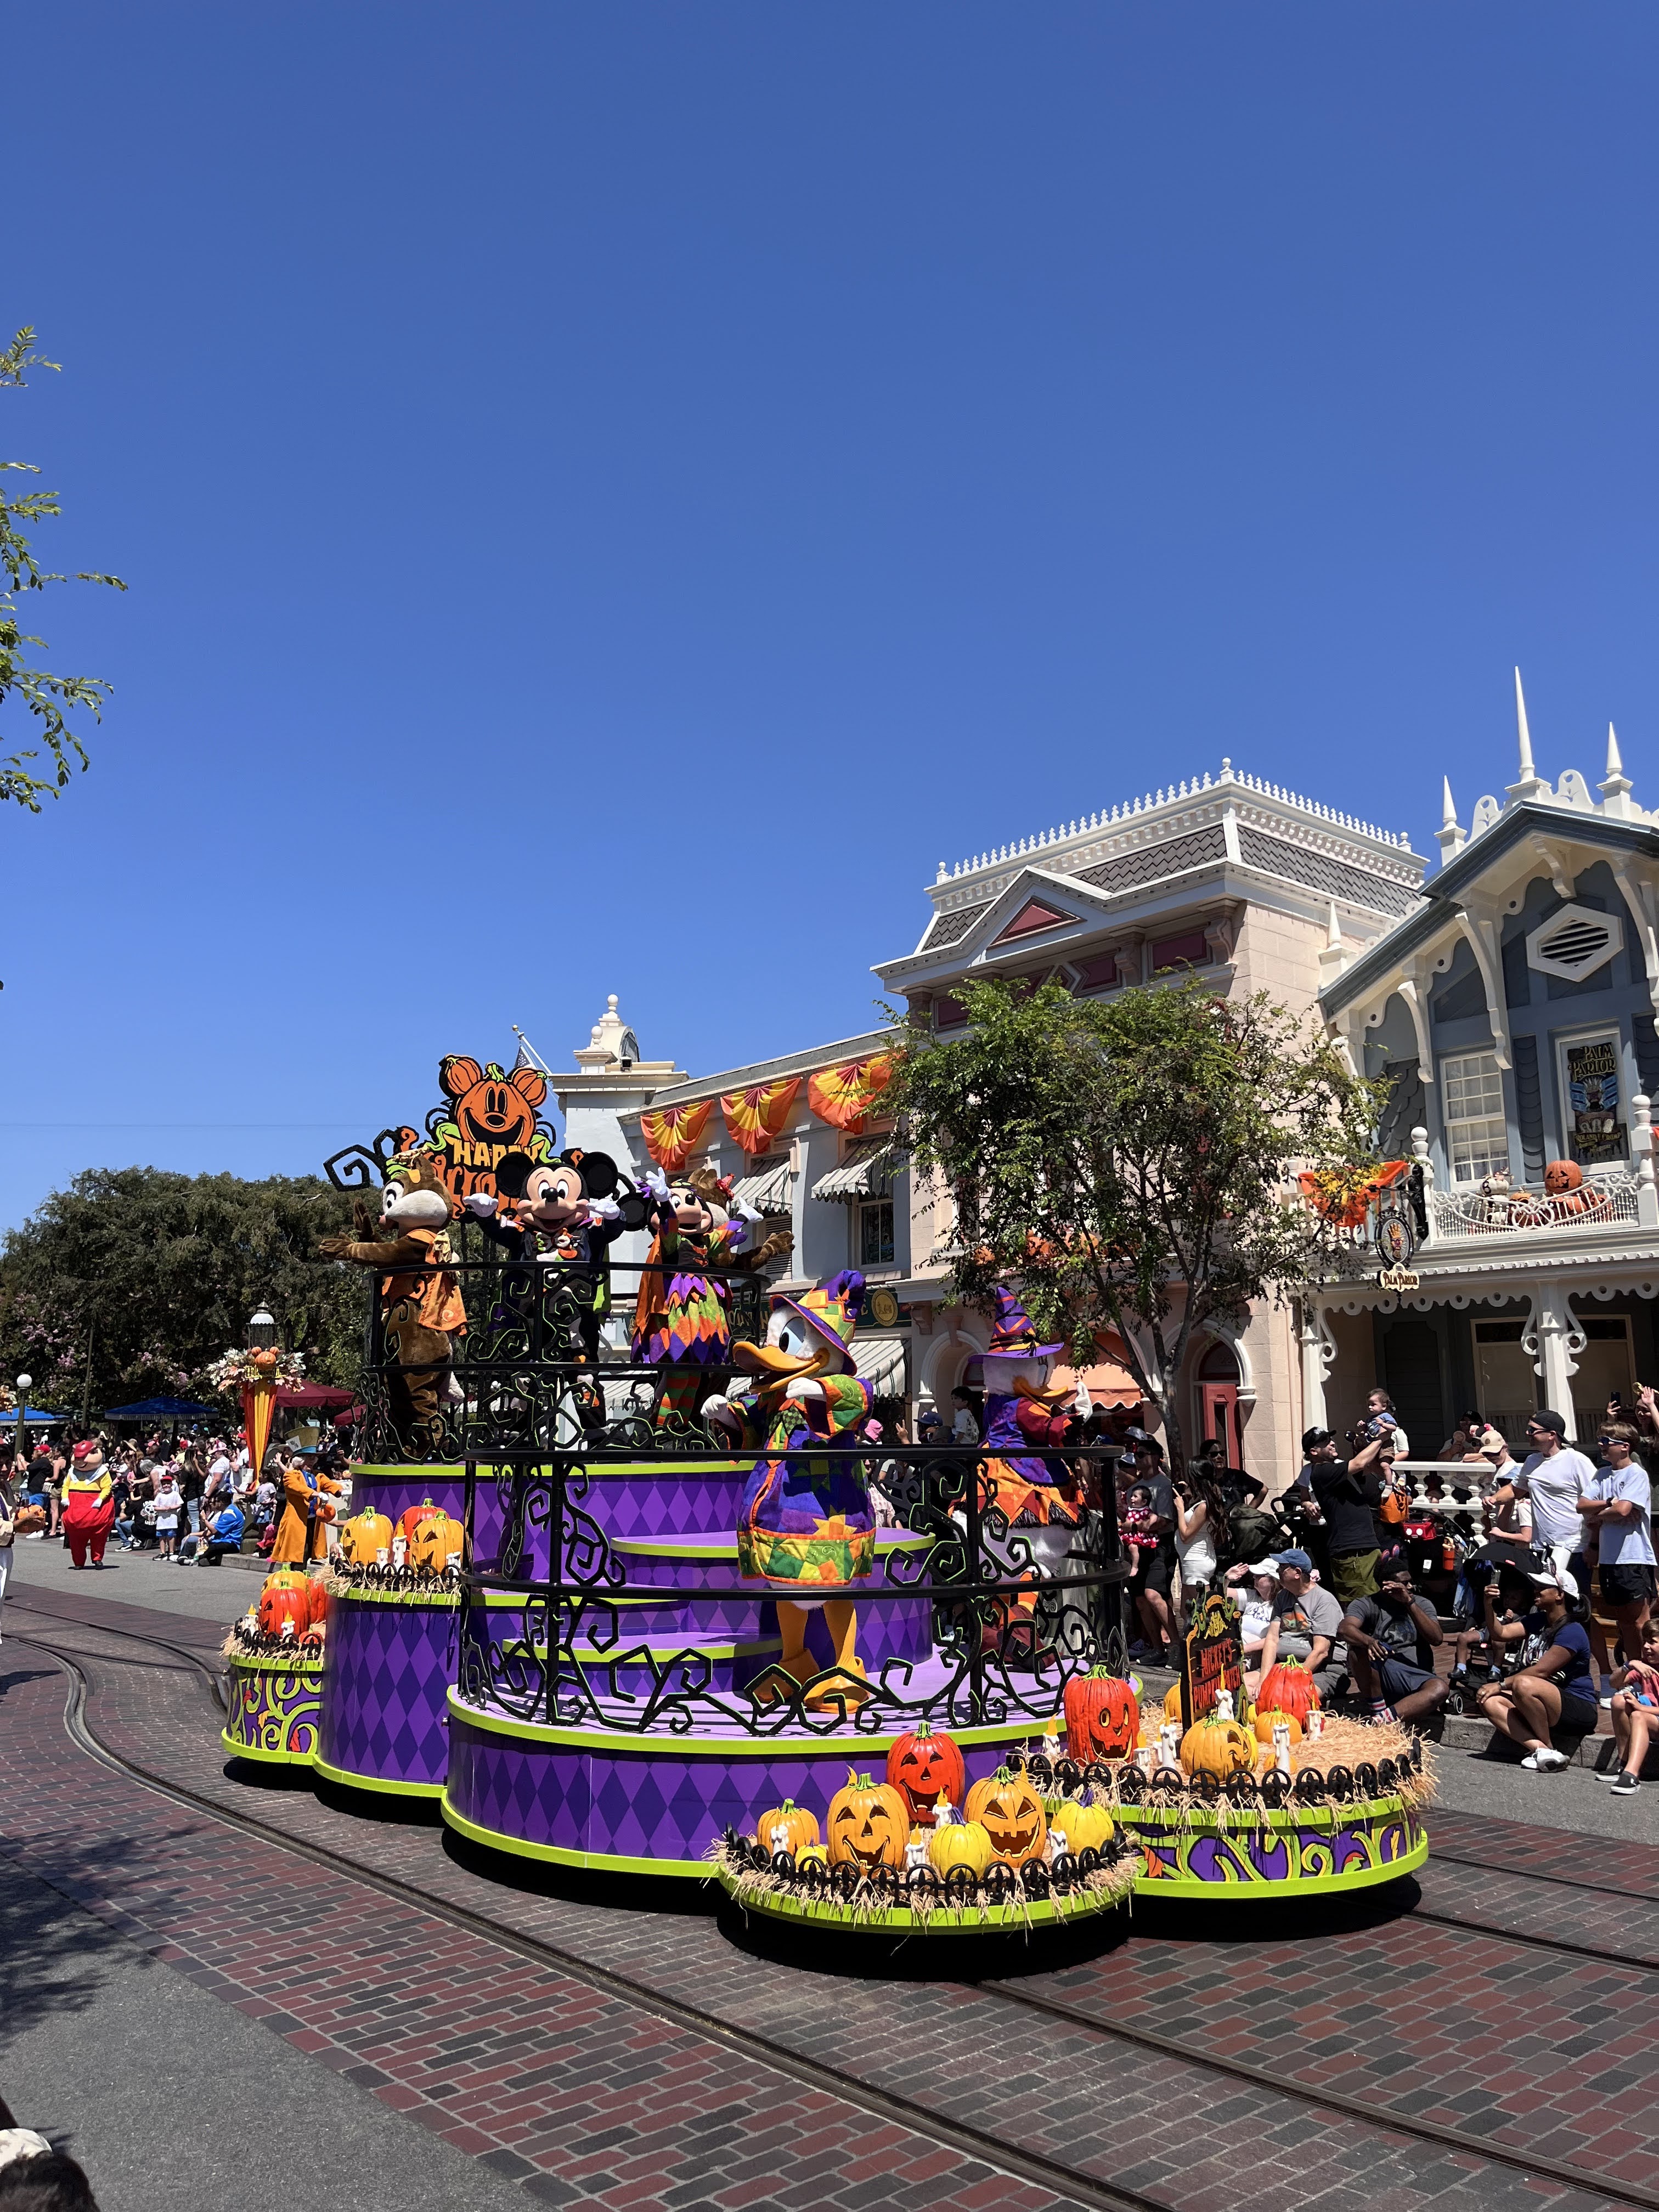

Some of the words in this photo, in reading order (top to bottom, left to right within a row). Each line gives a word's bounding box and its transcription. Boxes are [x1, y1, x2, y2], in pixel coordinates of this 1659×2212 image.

[1580, 1043, 1615, 1062] PALM
[1568, 1059, 1617, 1082] PARLOR
[1383, 1272, 1398, 1288] PALM
[1397, 1272, 1418, 1290] PARLOR
[1200, 1638, 1232, 1678] MICKEY'S
